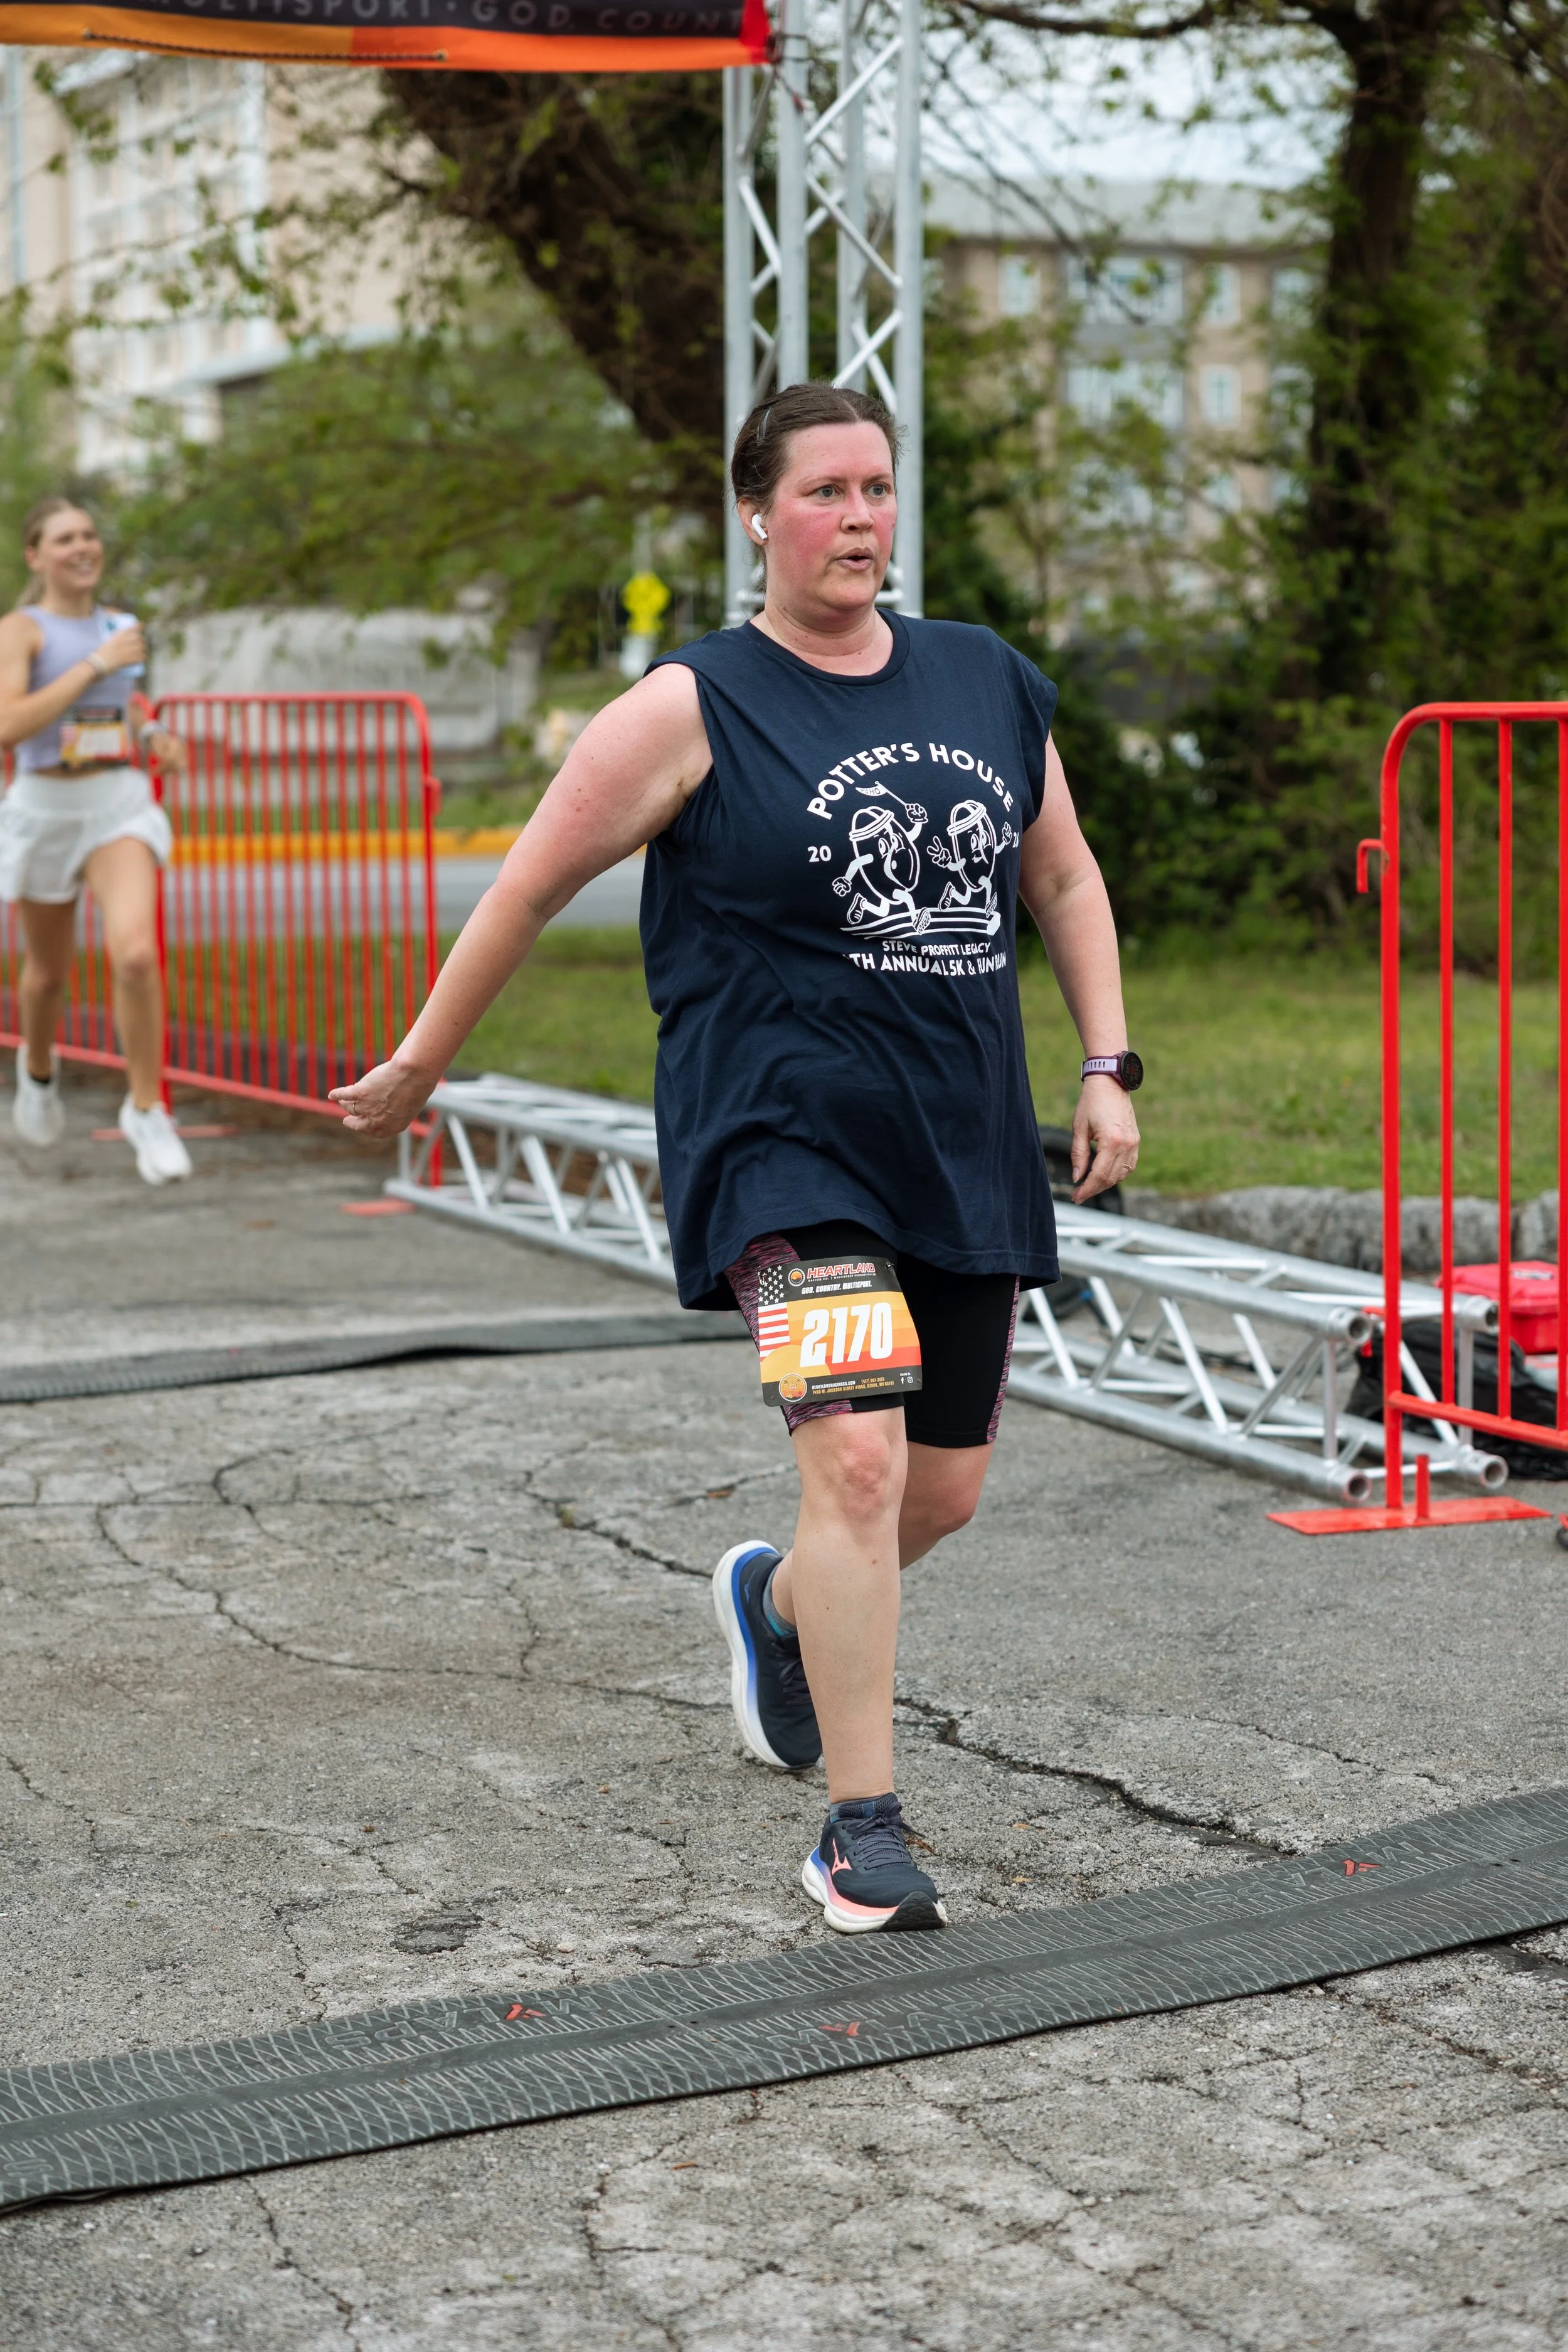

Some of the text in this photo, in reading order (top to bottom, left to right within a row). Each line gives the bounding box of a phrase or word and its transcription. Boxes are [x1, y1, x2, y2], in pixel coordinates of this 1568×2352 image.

[141, 0, 432, 18] ISPORT
[807, 742, 1014, 820] POTTER'S HOUSE
[807, 845, 832, 862] 20
[882, 940, 991, 956] STEVE PROFFITT LEGACY
[842, 953, 876, 970] TH
[880, 955, 948, 976] ANNUAL
[948, 959, 966, 976] 5K
[967, 960, 977, 975] &
[995, 951, 1006, 971] RUN
[807, 1263, 876, 1279] HEARTLAND
[802, 1280, 872, 1295] GOD. COUNTRY. MULTISPORT.
[800, 1302, 893, 1367] 2170
